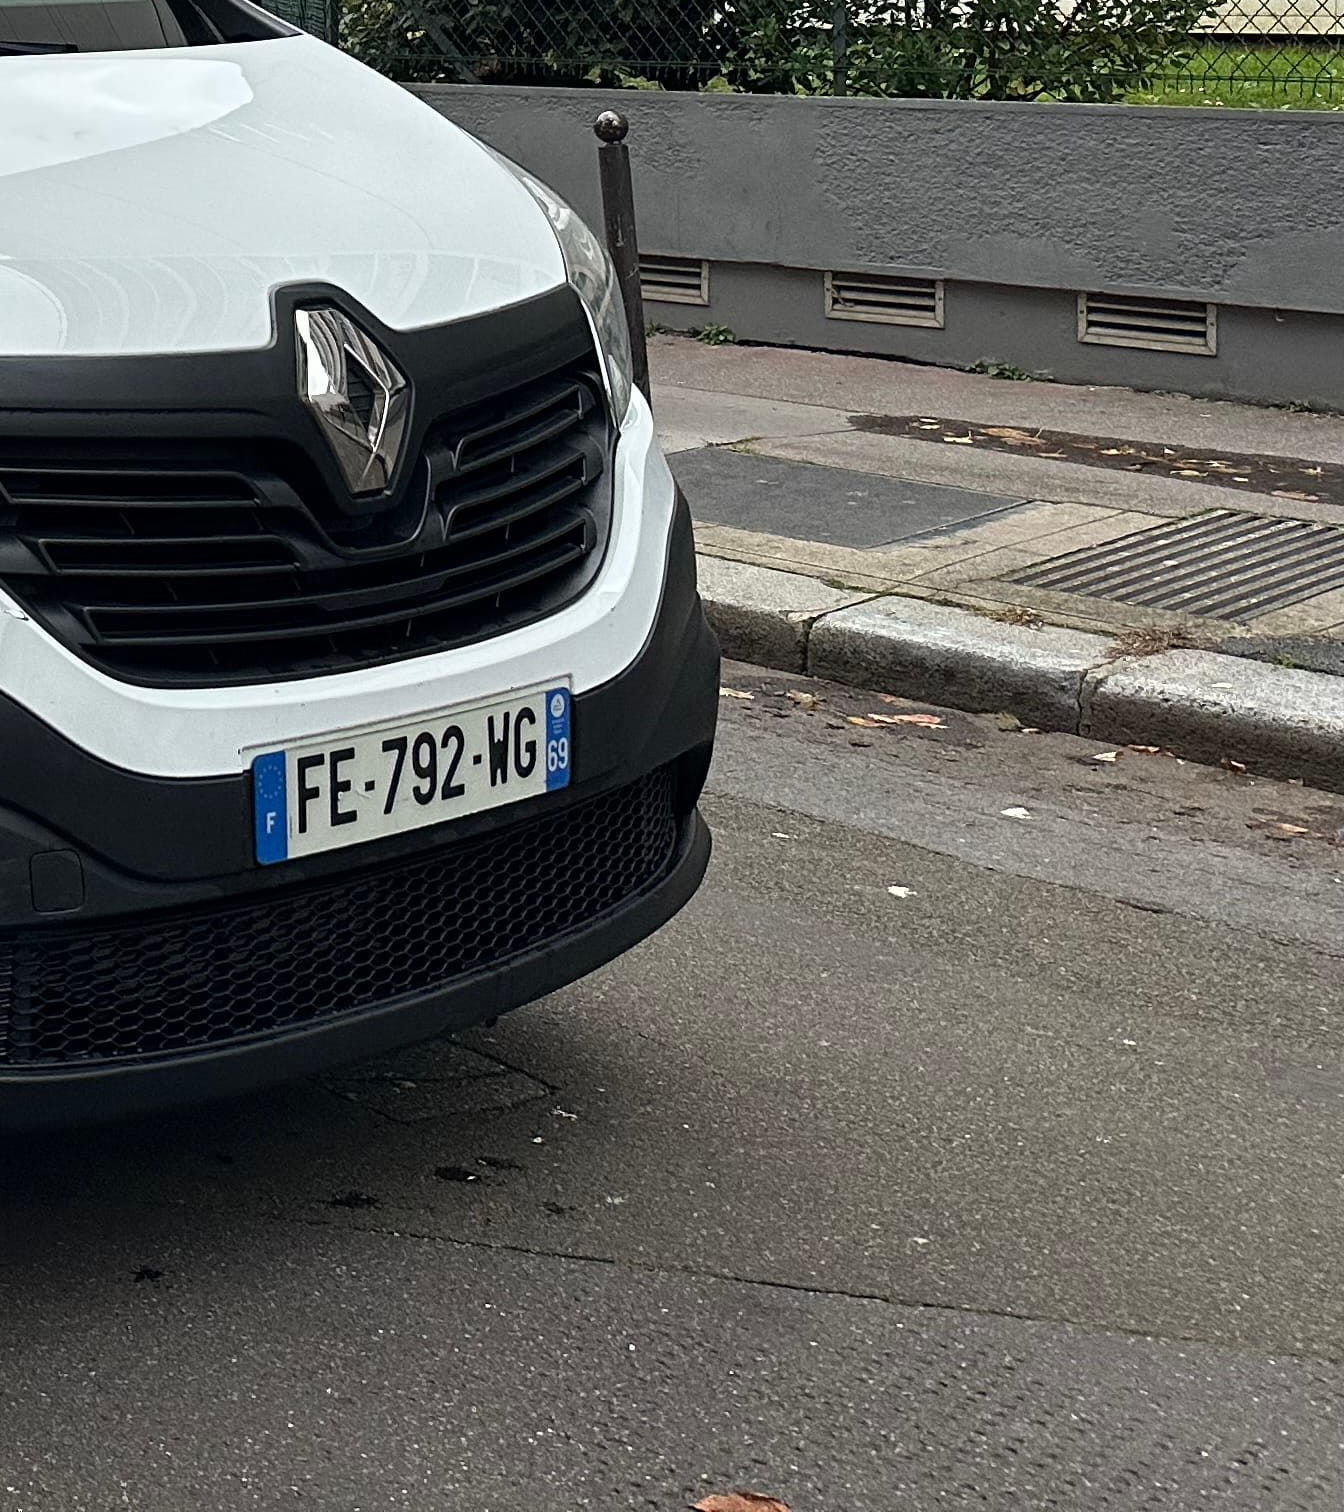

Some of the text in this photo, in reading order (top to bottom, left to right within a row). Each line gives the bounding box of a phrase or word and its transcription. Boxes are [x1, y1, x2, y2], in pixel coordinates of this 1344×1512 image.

[296, 706, 537, 834] FE-792-WG
[547, 736, 568, 772] 69
[265, 811, 277, 834] F
